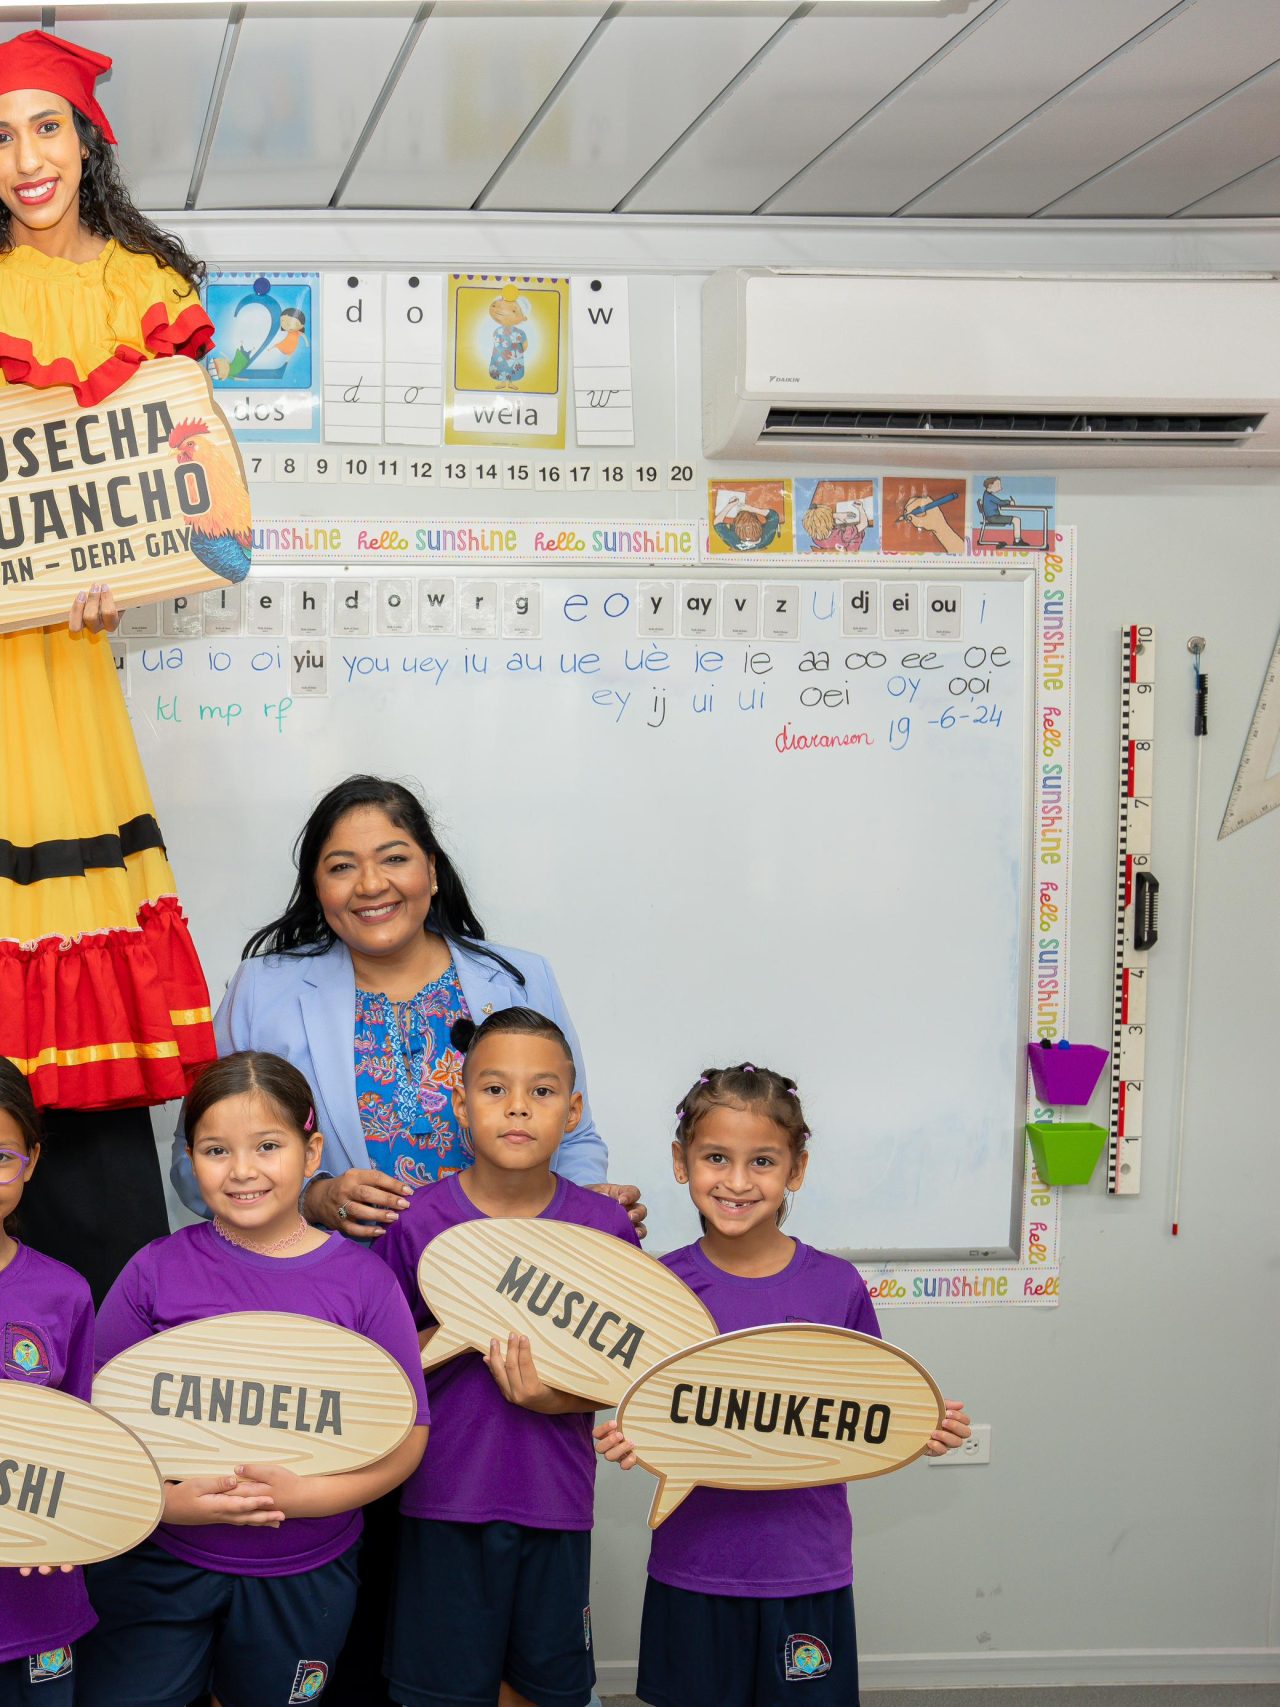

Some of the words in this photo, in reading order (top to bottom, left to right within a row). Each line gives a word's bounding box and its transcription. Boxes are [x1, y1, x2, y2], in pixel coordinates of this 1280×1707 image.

[345, 298, 363, 323] d
[406, 305, 424, 324] o
[587, 307, 614, 325] w
[233, 396, 285, 422] dos
[251, 458, 262, 473] 7
[284, 458, 296, 474] 8
[316, 458, 329, 474] 9
[345, 459, 368, 475] 10
[378, 460, 398, 476] 11
[410, 462, 433, 478] 12
[444, 463, 467, 479] 13
[476, 464, 498, 480] 14
[506, 465, 529, 480] 15
[538, 467, 561, 482] 16
[569, 466, 591, 482] 17
[602, 466, 624, 482] 18
[635, 466, 658, 482] 19
[670, 466, 694, 482] 20
[71, 539, 137, 573] DERA
[145, 526, 192, 559] GAY
[251, 527, 342, 551] unshine
[357, 530, 409, 551] hello
[415, 528, 517, 553] sunshine
[534, 531, 586, 552] hello
[592, 530, 692, 553] sunshine
[174, 595, 188, 614] p
[259, 595, 273, 609] e
[302, 590, 316, 610] h
[344, 590, 359, 609] d
[387, 594, 402, 608] o
[427, 593, 445, 607] w
[475, 596, 484, 610] r
[515, 596, 529, 615] g
[563, 594, 588, 622] e
[650, 596, 663, 614] y
[686, 597, 712, 616] ay
[734, 598, 747, 612] v
[775, 599, 787, 613] z
[851, 590, 869, 614] dj
[892, 593, 910, 612] ei
[931, 599, 957, 613] ou
[1043, 589, 1065, 691] sunshine
[1138, 626, 1153, 644] 10
[293, 649, 324, 673] yiu
[341, 655, 391, 683] you
[402, 655, 450, 687] uey
[506, 652, 543, 673] au
[559, 652, 601, 675] ue
[901, 651, 945, 671] ee
[199, 701, 243, 727] mp
[591, 689, 632, 724] ey
[1042, 706, 1062, 758] hello
[1135, 741, 1151, 751] 8
[1134, 798, 1150, 809] 7
[1040, 763, 1063, 865] sunshine
[1039, 881, 1059, 932] hello
[1130, 969, 1145, 979] 4
[1036, 938, 1060, 1040] sunshine
[1128, 1025, 1143, 1035] 3
[1126, 1081, 1141, 1092] 2
[864, 1278, 907, 1299] ello
[912, 1275, 1009, 1298] sunshine
[494, 1254, 646, 1370] MUSICA
[150, 1371, 344, 1437] CANDELA
[669, 1382, 892, 1446] CUNUKERO
